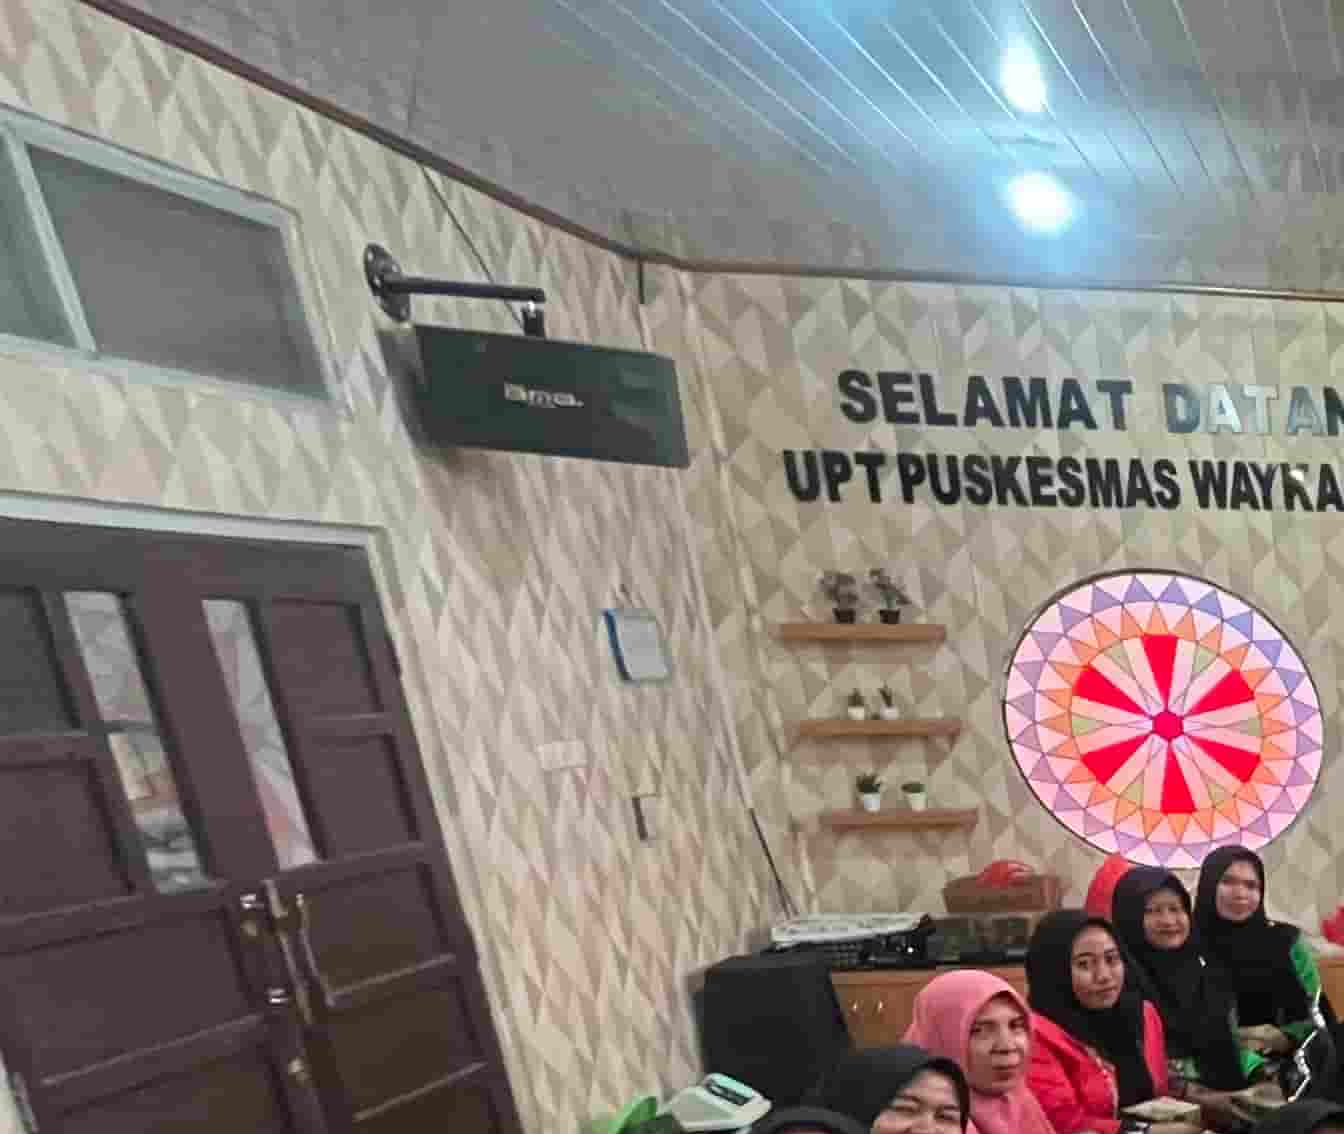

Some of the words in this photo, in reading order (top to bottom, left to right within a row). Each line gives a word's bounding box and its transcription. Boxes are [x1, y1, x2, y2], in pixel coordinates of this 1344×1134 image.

[838, 369, 1134, 431] SELAMAT
[783, 449, 887, 503] UPT
[897, 452, 1181, 510] PUSKESMAS
